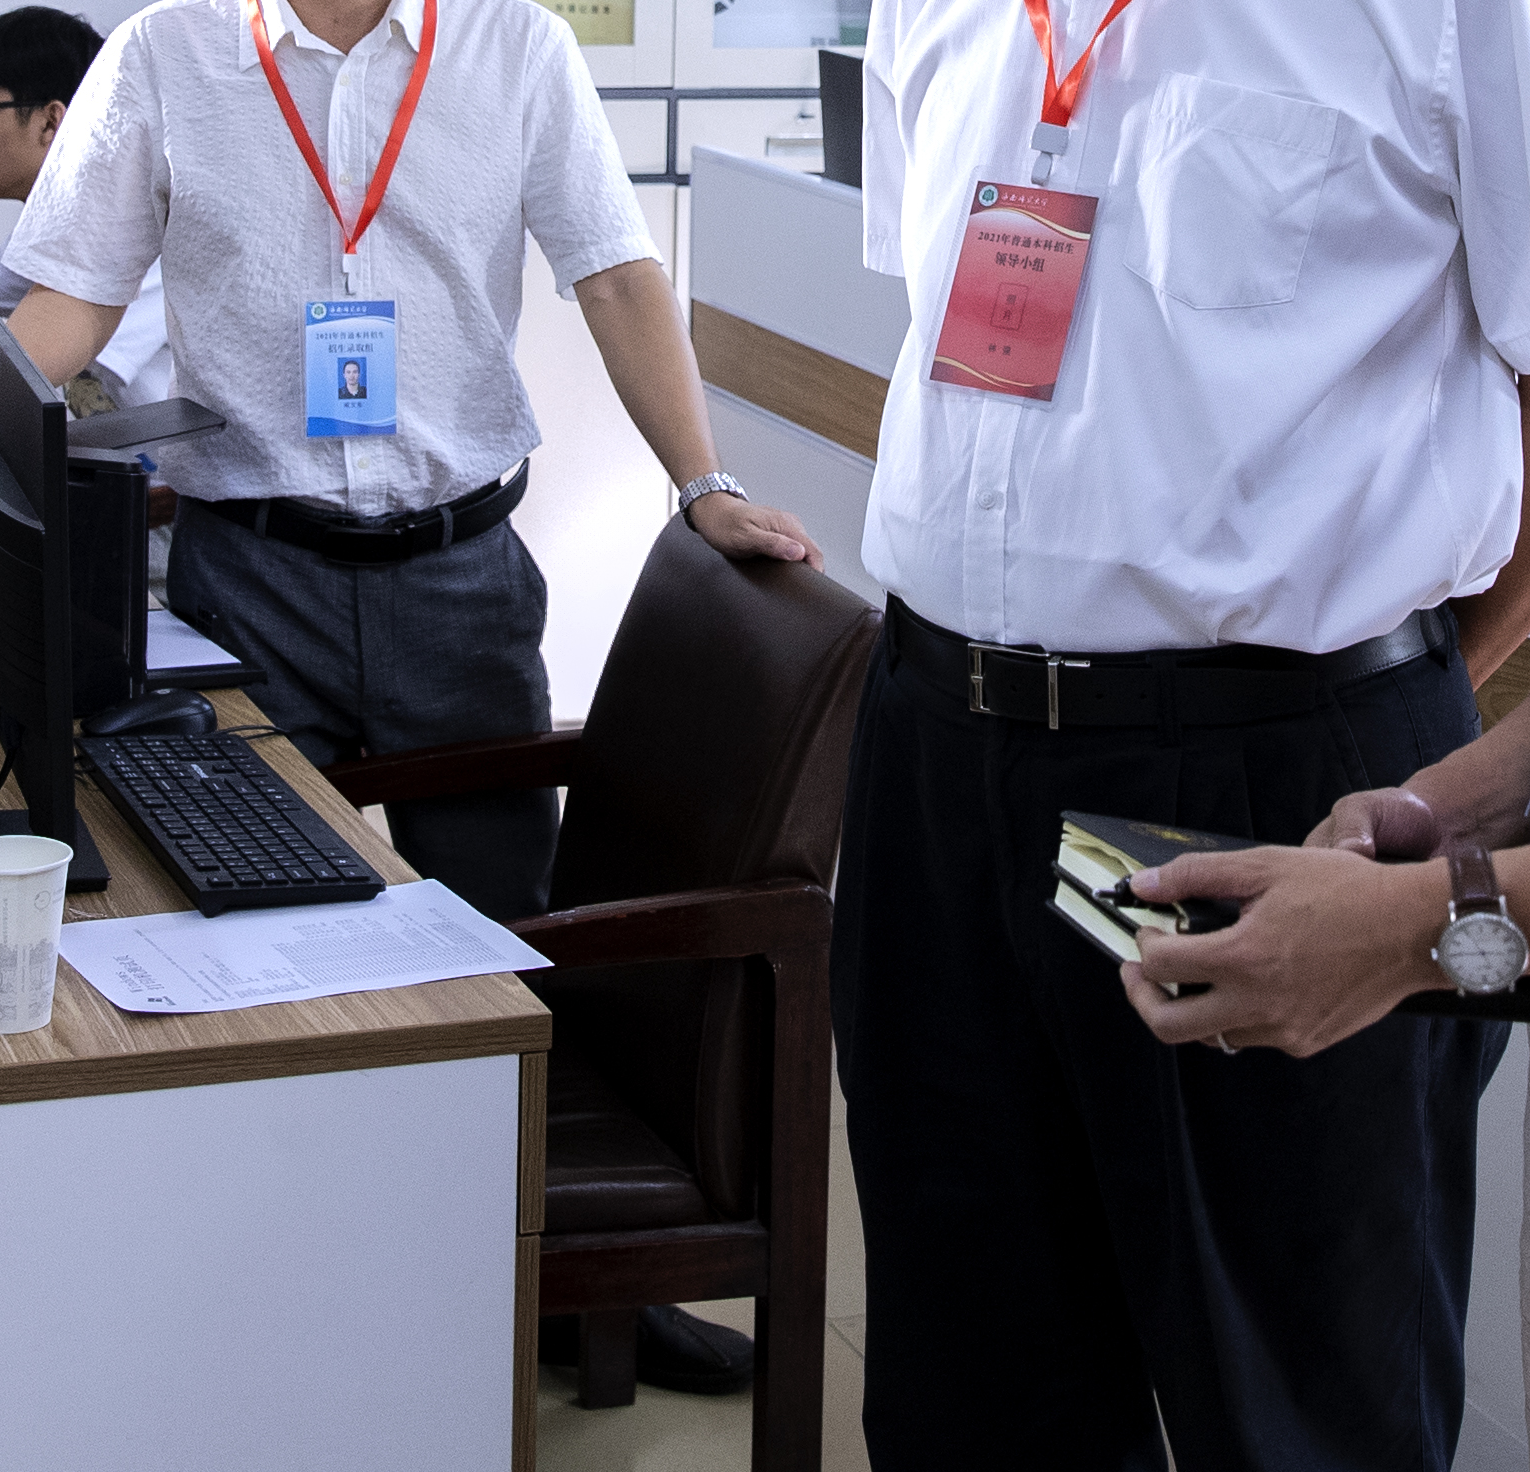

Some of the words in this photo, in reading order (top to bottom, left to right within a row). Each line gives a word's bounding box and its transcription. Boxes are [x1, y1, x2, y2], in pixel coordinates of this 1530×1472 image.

[977, 231, 1074, 254] 2021年普通本科招生
[995, 252, 1045, 272] 领导小组
